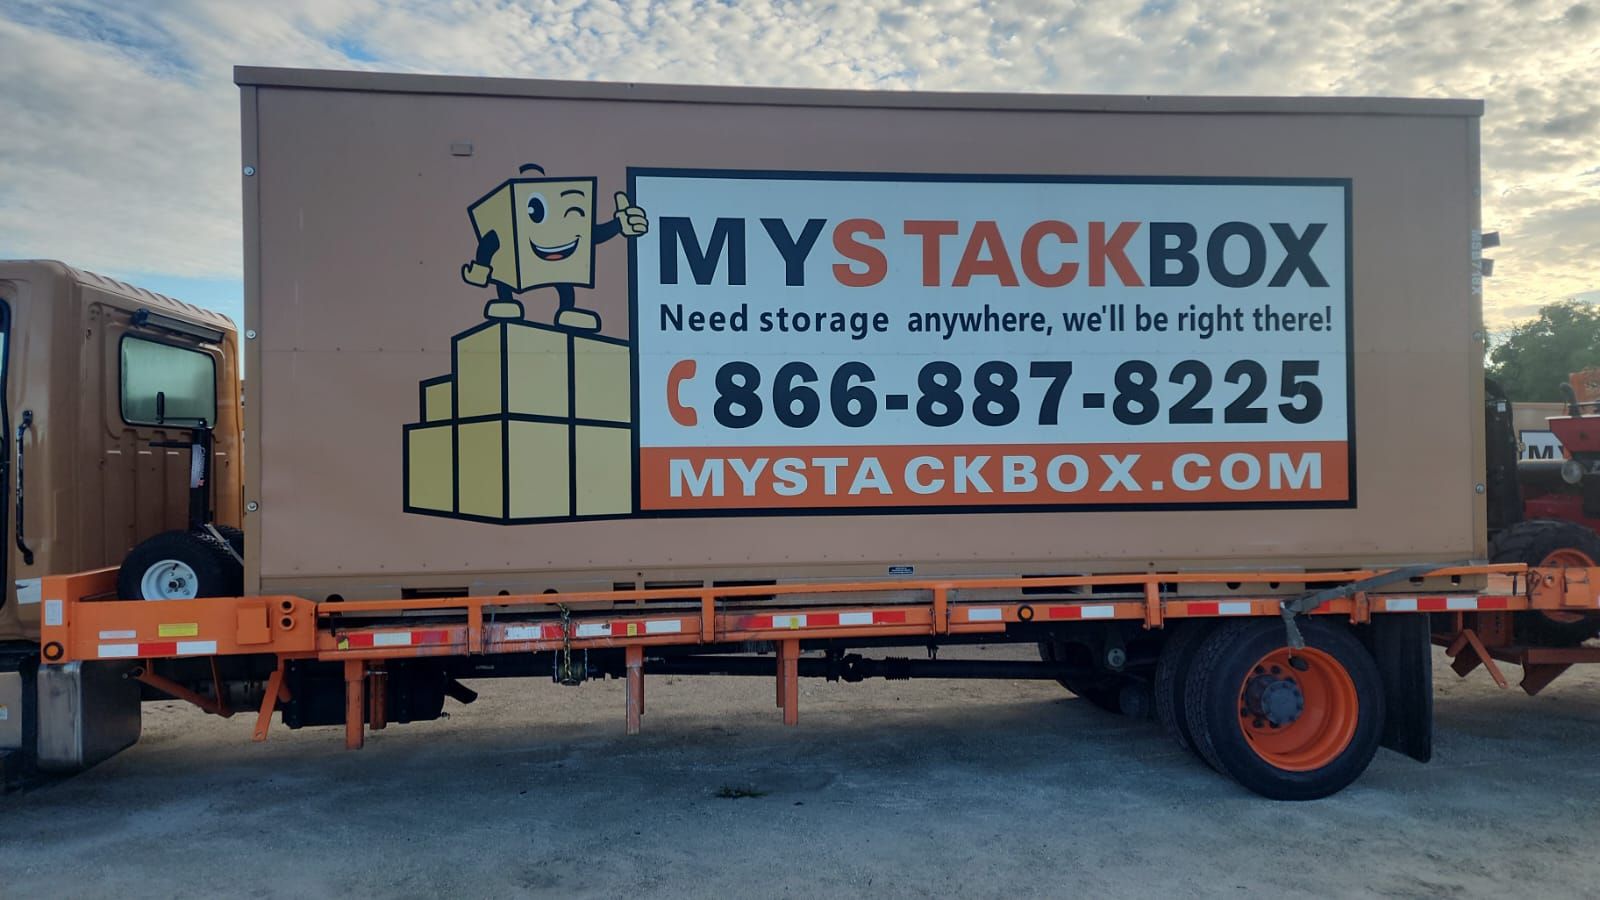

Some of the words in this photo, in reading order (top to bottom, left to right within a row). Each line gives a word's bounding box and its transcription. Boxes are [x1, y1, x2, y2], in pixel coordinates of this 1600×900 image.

[660, 304, 748, 332] Need
[759, 307, 889, 340] storage
[907, 304, 1052, 340] anywhere,
[1062, 304, 1125, 332] we'll
[1136, 304, 1169, 332] be
[1178, 304, 1244, 339] right
[1253, 304, 1332, 332] there!
[713, 359, 1323, 428] 866-887-8225
[669, 452, 1322, 497] MYSTACKBOX.COM
